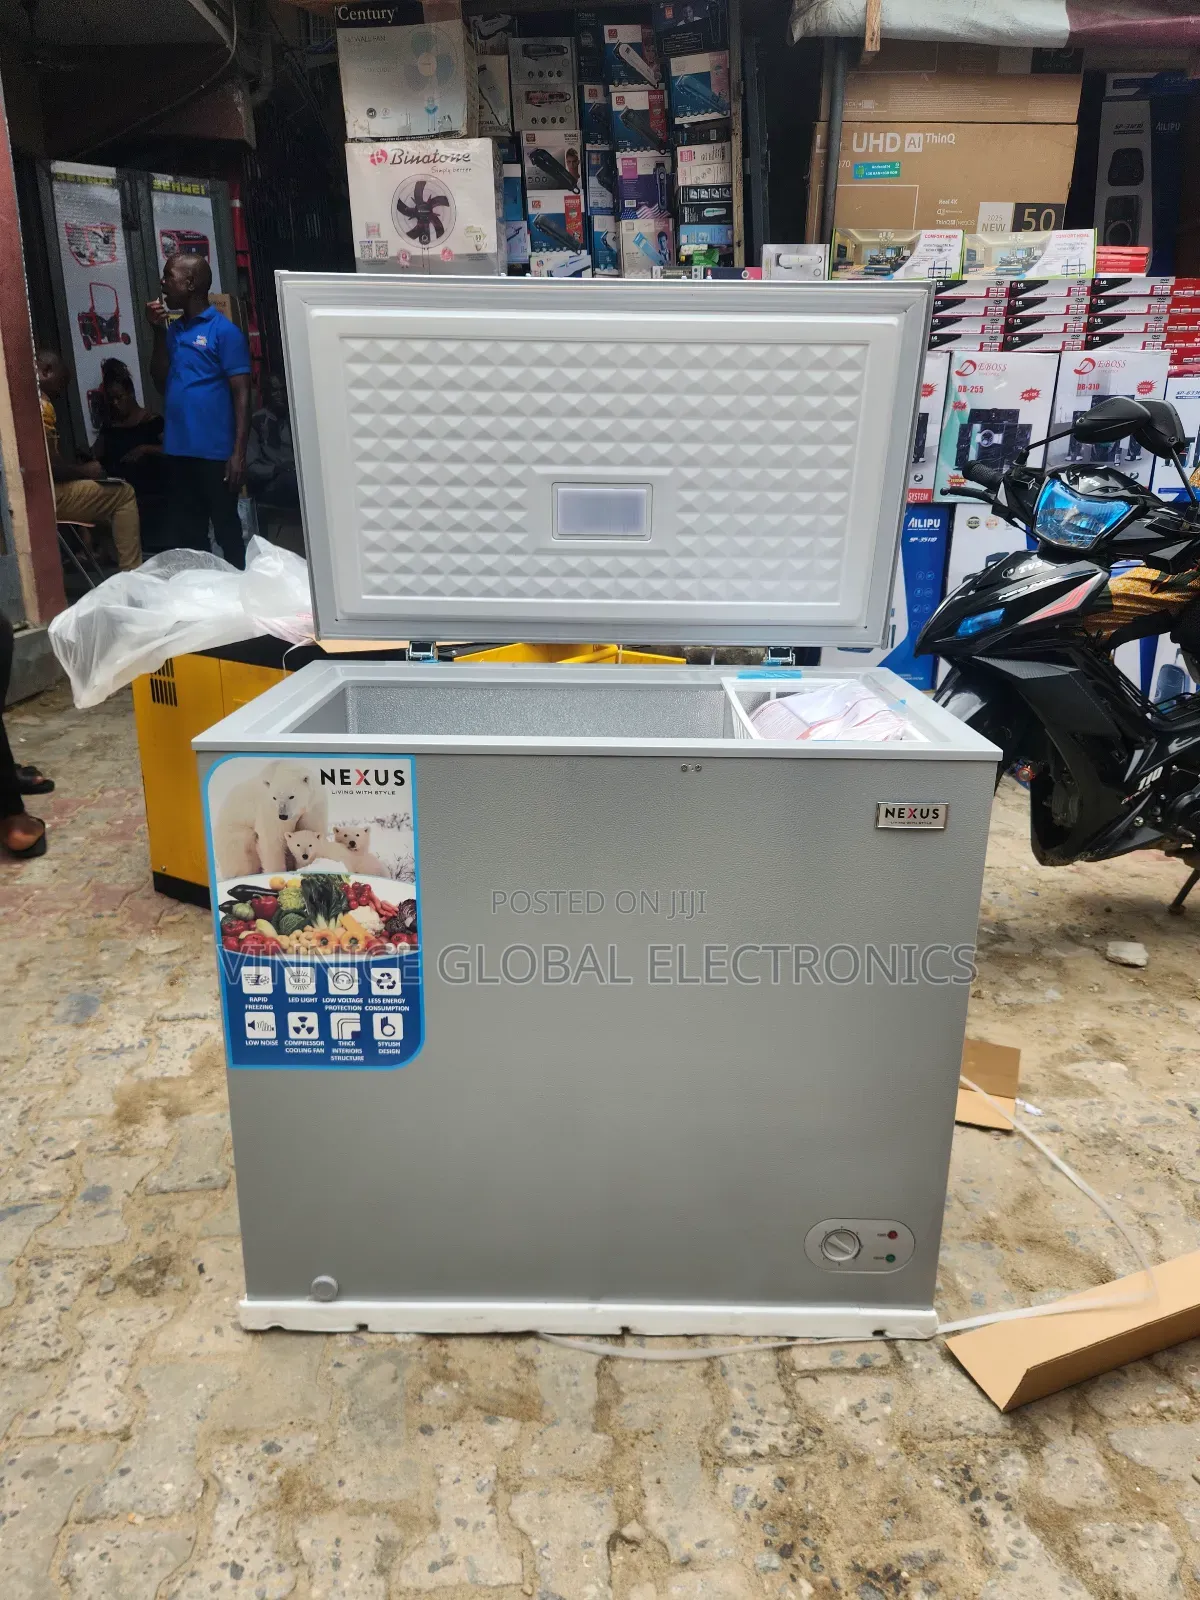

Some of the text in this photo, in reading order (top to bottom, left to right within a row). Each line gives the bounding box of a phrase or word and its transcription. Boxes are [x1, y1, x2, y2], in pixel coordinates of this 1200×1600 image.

[338, 6, 395, 24] Century
[1156, 121, 1180, 131] AILIPU
[852, 132, 901, 153] UHD
[906, 134, 922, 152] AI
[925, 133, 956, 144] ThinQ
[390, 148, 471, 165] Binatone
[431, 165, 472, 174] Simply better
[152, 178, 206, 195] SENWEI
[1021, 208, 1056, 232] 50
[981, 223, 1006, 232] NEW
[957, 385, 984, 393] DB-255
[908, 491, 929, 501] SYSTEM
[907, 517, 941, 528] AILIPU
[1018, 559, 1043, 574] TVS
[320, 768, 405, 787] NEXUS
[884, 807, 940, 819] NEXUS
